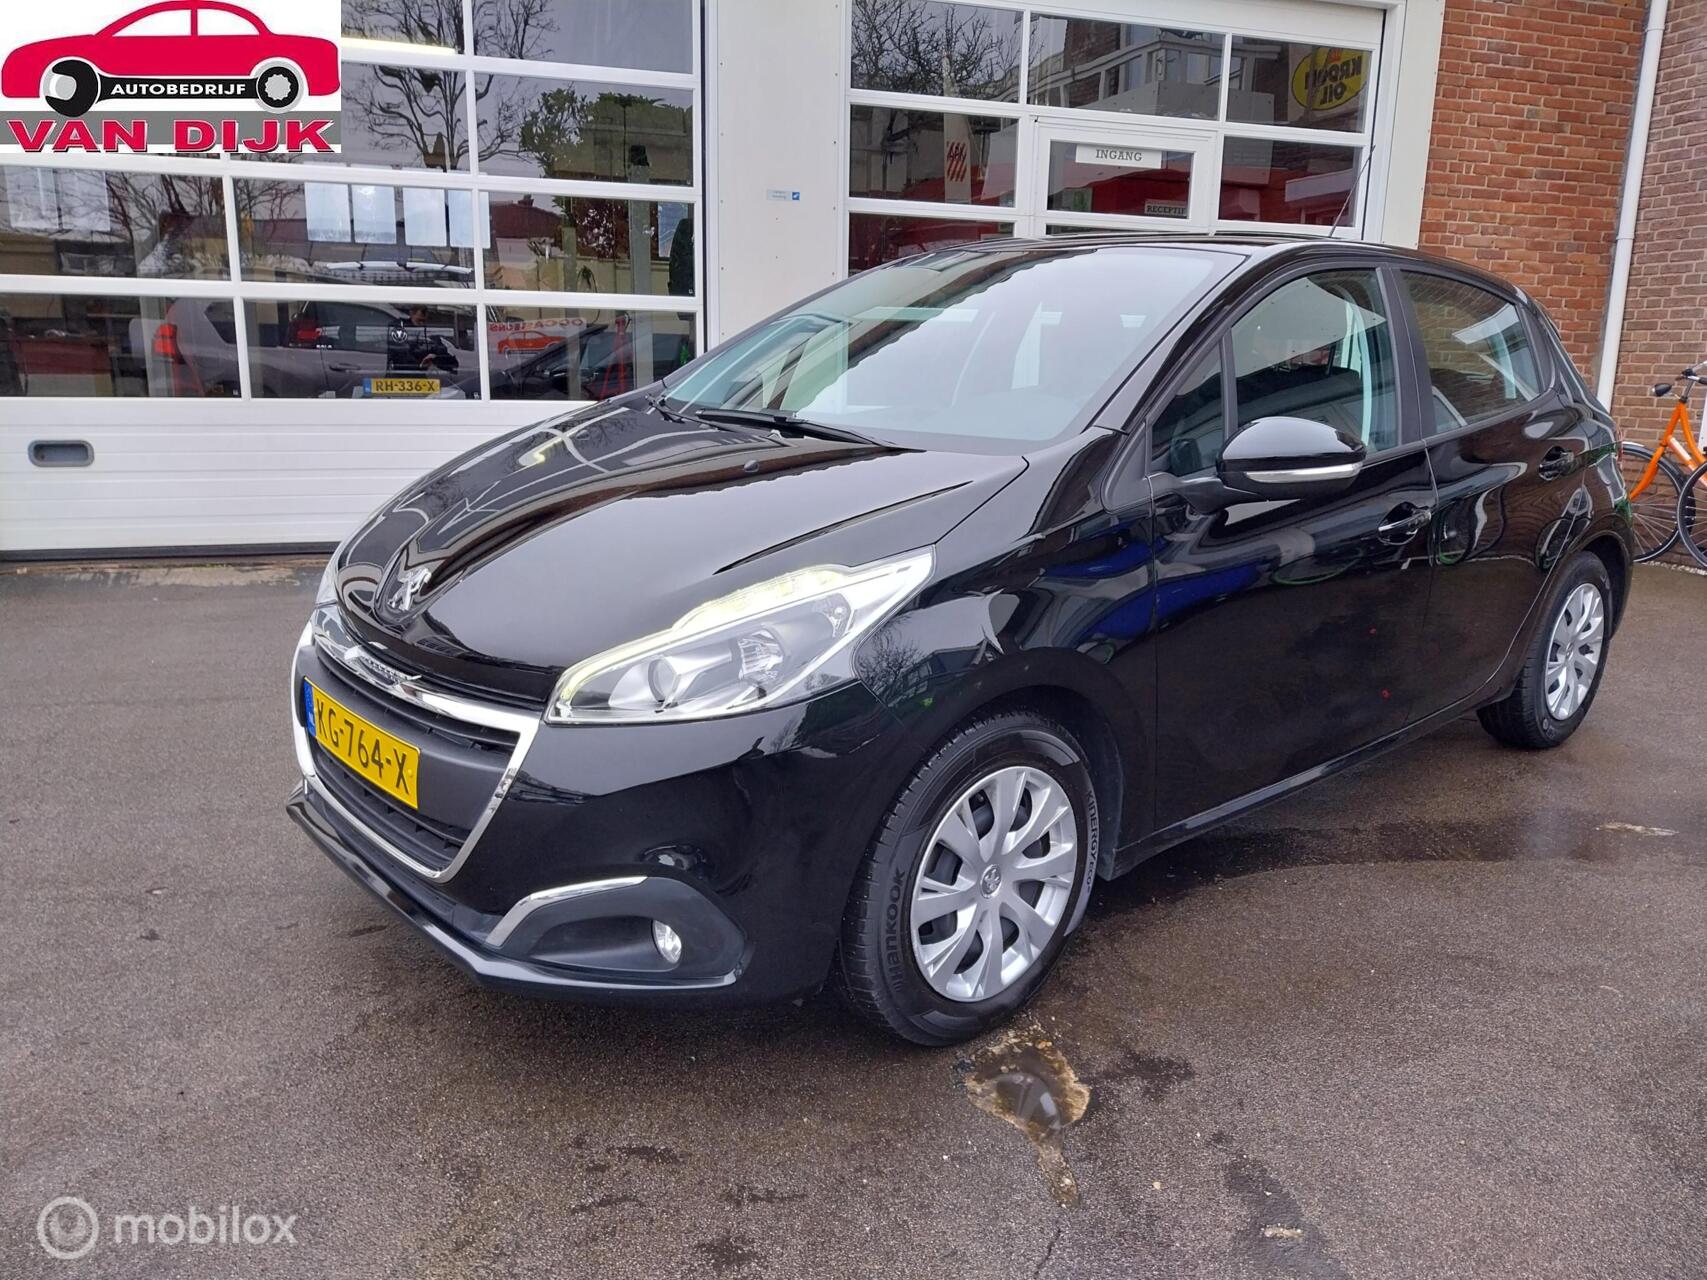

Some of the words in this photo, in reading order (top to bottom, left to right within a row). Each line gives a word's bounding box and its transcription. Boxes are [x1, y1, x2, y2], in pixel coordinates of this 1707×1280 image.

[1095, 149, 1143, 162] INGANG
[375, 380, 435, 392] RH-336-X
[316, 698, 410, 796] KG-764-X
